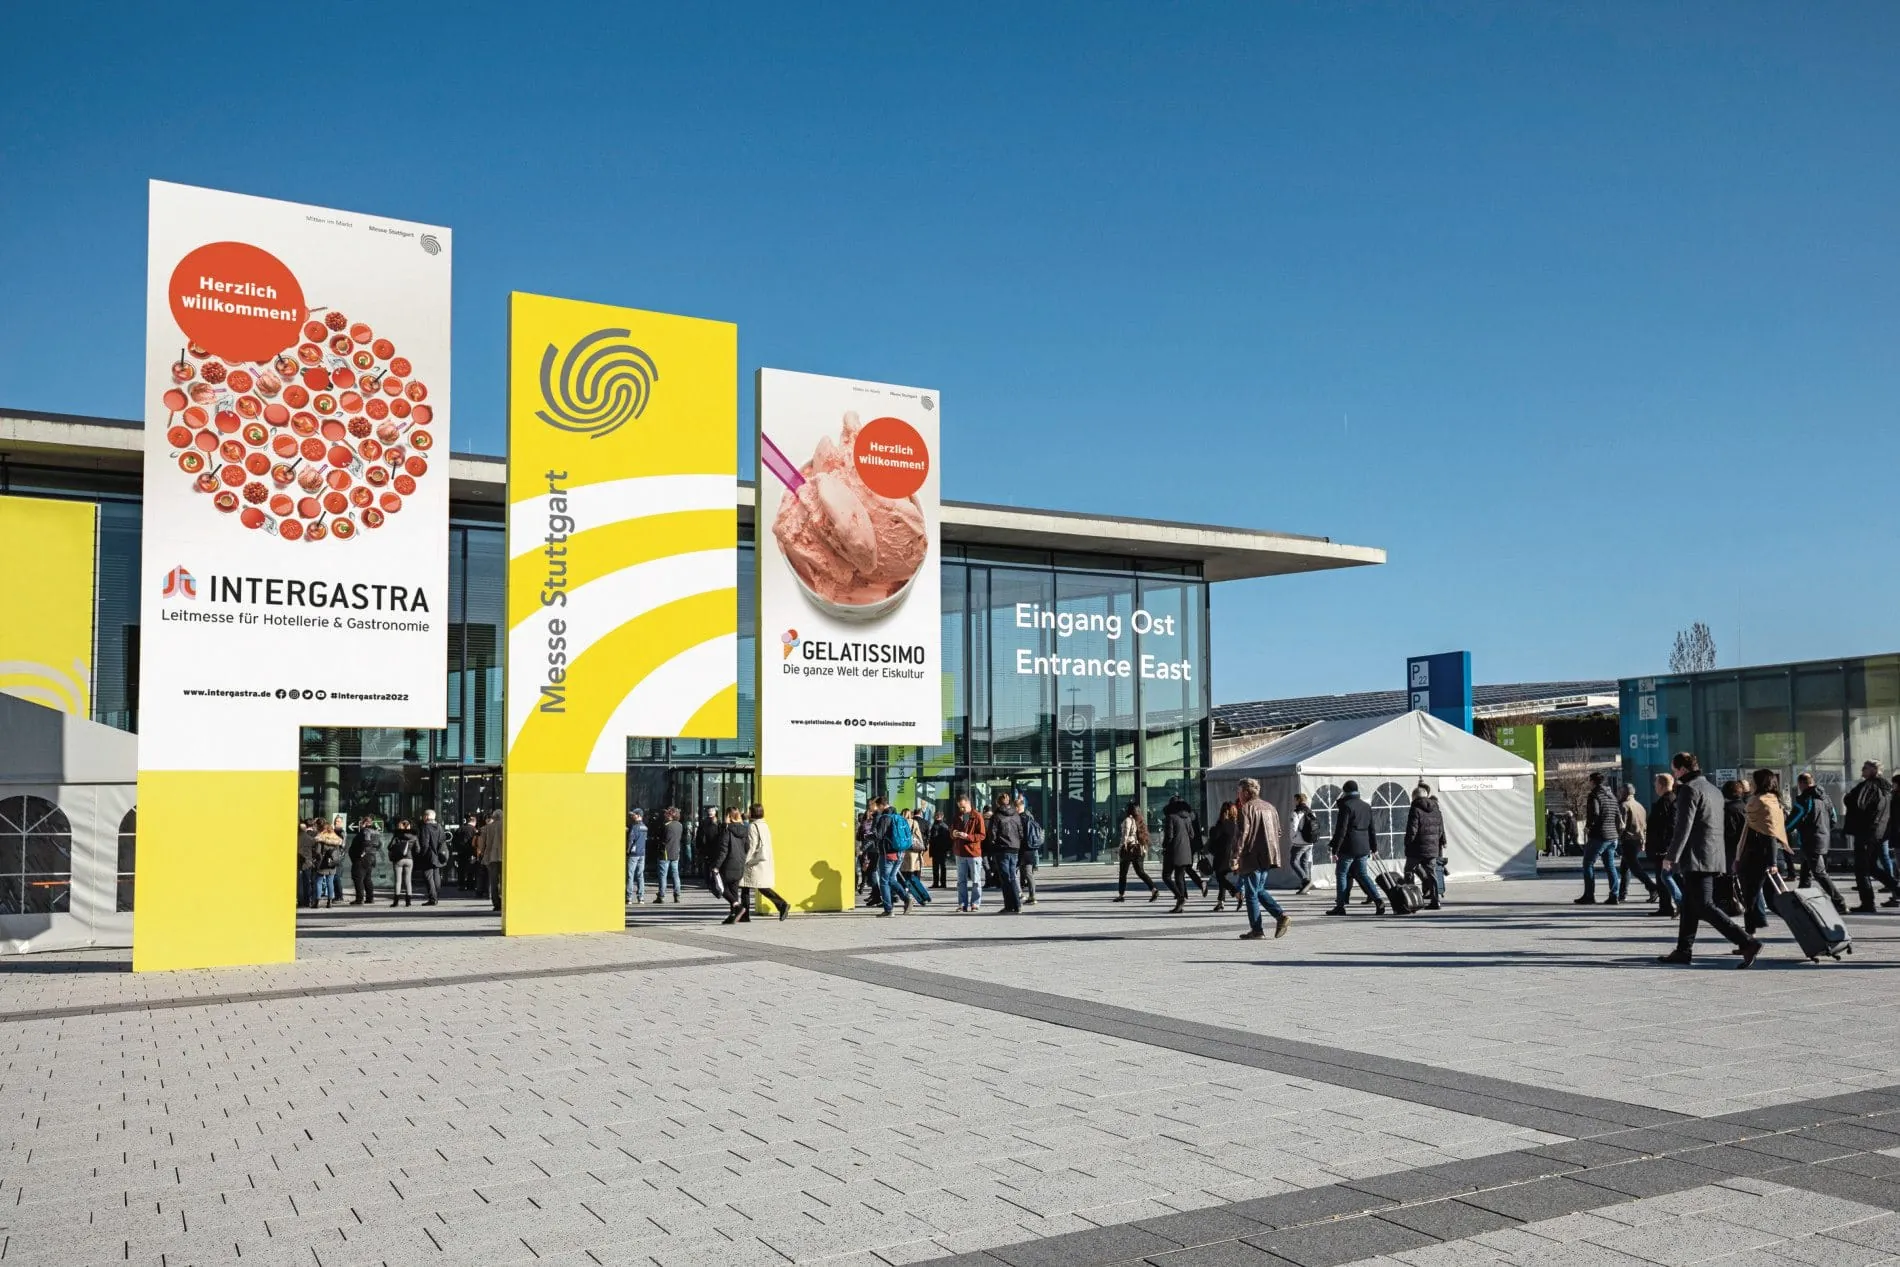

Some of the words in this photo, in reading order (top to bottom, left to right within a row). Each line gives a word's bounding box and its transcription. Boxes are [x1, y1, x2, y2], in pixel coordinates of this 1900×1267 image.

[199, 276, 277, 299] Herzlich
[181, 294, 297, 321] willkommen!
[869, 441, 913, 456] Herzlich
[858, 454, 925, 470] willkommen!
[540, 469, 575, 608] Stuttgart
[210, 575, 430, 613] INTERGASTRA
[161, 608, 234, 624] Leitmesse
[239, 612, 259, 625] für
[263, 614, 330, 628] Hotellerie
[333, 617, 343, 629] &
[347, 617, 430, 632] Gastronomie
[1015, 602, 1122, 639] Eingang
[1131, 609, 1175, 636] Ost
[802, 640, 925, 665] GELATISSIMO
[1016, 648, 1131, 677] Entrance
[1140, 654, 1192, 681] East
[540, 619, 566, 713] Messe
[783, 664, 800, 675] Die
[803, 666, 834, 677] ganze
[837, 666, 859, 677] Welt
[862, 667, 879, 678] der
[882, 668, 925, 679] Eiskultur
[1412, 664, 1420, 680] P
[1418, 675, 1427, 685] 22
[183, 688, 271, 699] www.intergastra.de
[330, 691, 409, 701] #intergastra2022
[1068, 739, 1084, 801] Allianz
